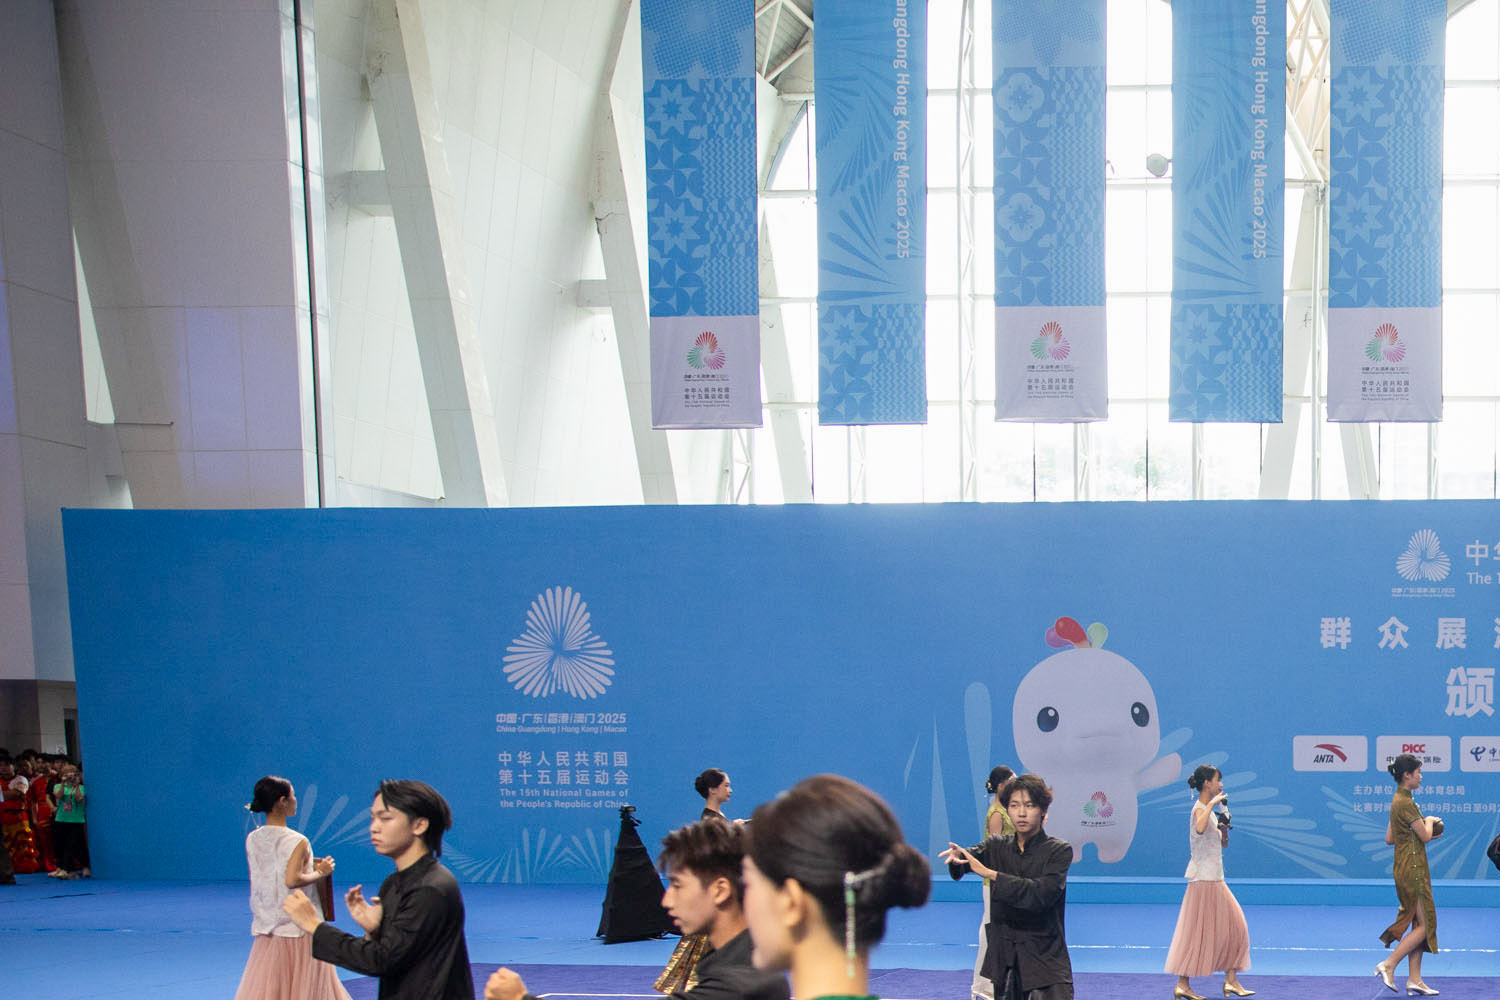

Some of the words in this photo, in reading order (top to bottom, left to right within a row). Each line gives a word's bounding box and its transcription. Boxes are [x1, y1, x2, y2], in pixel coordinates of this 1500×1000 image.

[893, 73, 909, 116] Hong
[1251, 71, 1268, 114] Hong
[893, 120, 909, 161] Kong
[1250, 119, 1267, 160] Kong
[897, 165, 909, 217] Macao
[1253, 164, 1266, 216] Macao
[897, 221, 909, 258] 2025
[1253, 220, 1266, 258] 2025
[1467, 572, 1491, 585] The
[597, 713, 626, 724] 2025
[498, 751, 628, 767] 中华人民共和国
[1313, 755, 1334, 763] ANTA
[1402, 744, 1425, 753] PICC
[498, 769, 629, 785] 第十五届运动会
[543, 789, 582, 797] National
